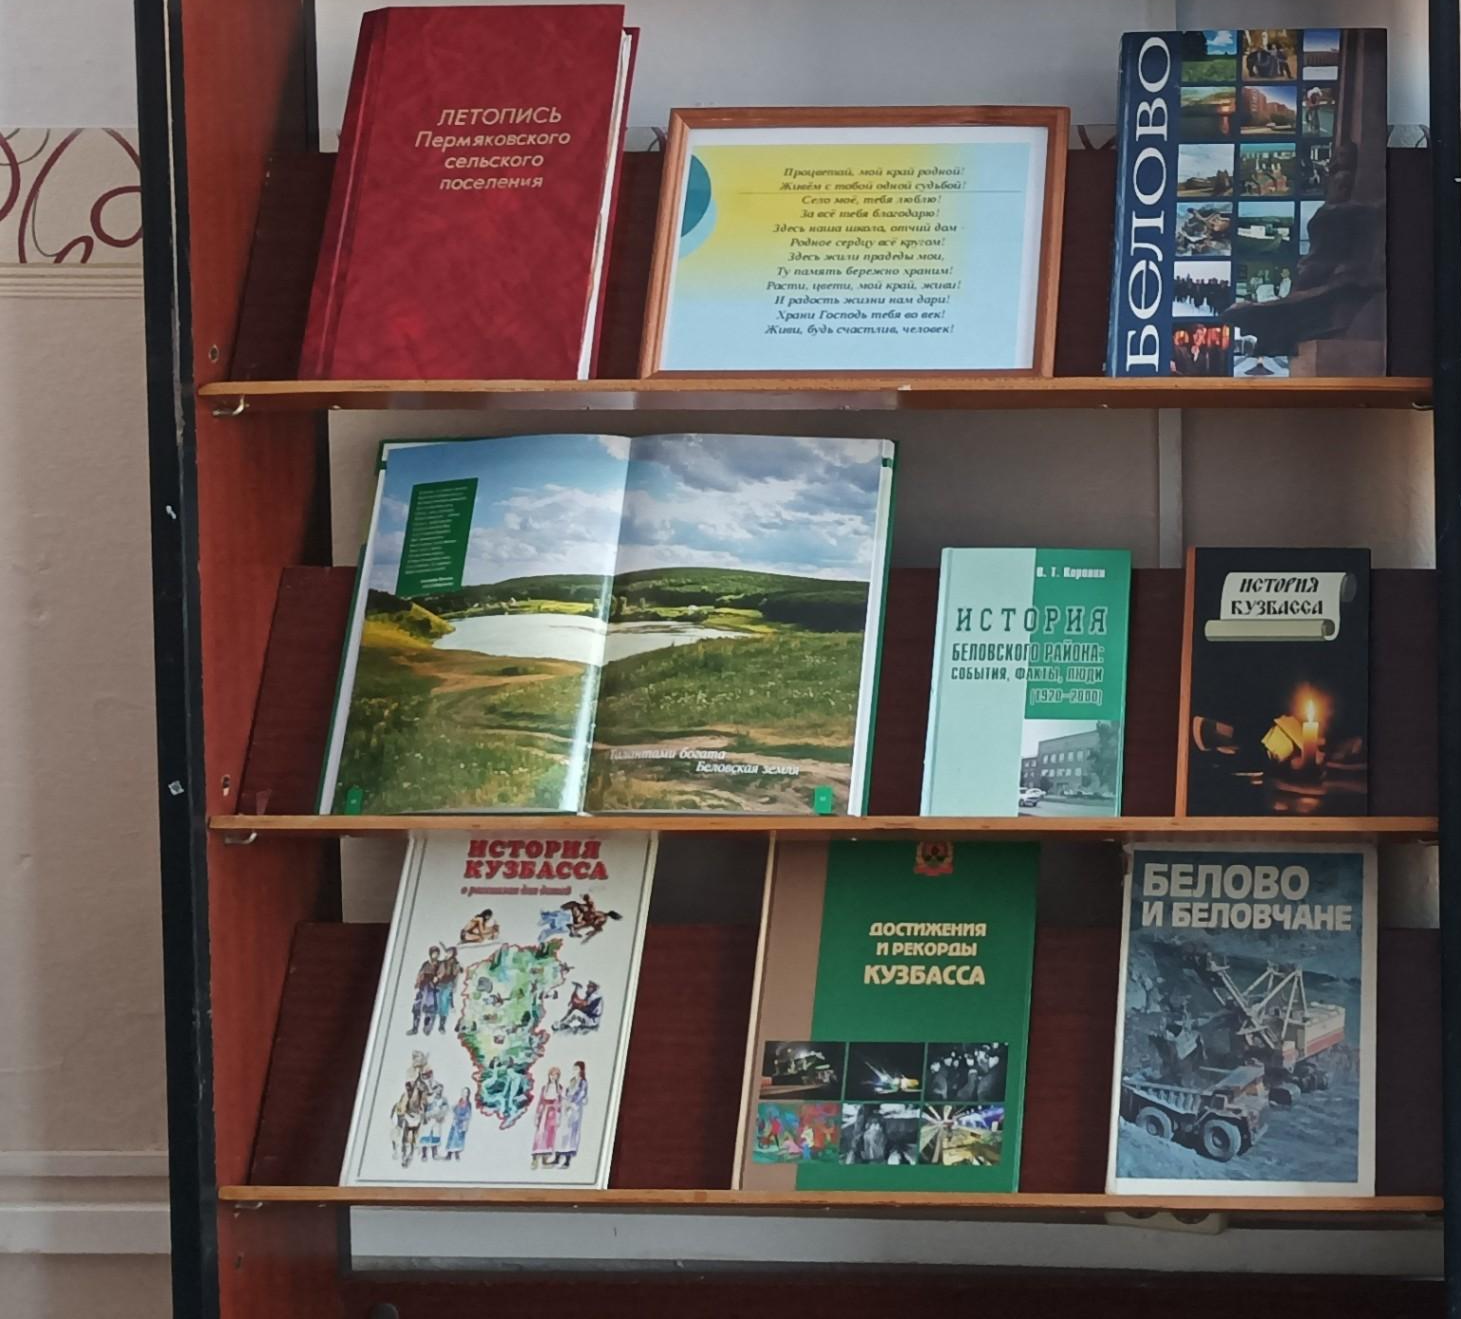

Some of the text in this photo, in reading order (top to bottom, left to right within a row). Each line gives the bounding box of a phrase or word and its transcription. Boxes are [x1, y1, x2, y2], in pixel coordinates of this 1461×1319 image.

[437, 107, 562, 126] ЛЕТОПИСЬ
[415, 131, 570, 152] Пермяковского
[445, 154, 544, 169] сельского
[859, 168, 883, 176] мой
[886, 168, 914, 178] край
[440, 175, 543, 191] поселения
[835, 182, 873, 191] тобой
[876, 182, 912, 191] одной
[863, 195, 893, 204] тебя
[839, 209, 869, 218] тебя
[773, 224, 805, 233] Здесь
[790, 238, 832, 247] Родное
[788, 253, 820, 261] Здесь
[824, 253, 860, 261] жили
[794, 267, 842, 276] память
[845, 266, 900, 278] бережно
[859, 281, 883, 290] мой
[788, 296, 840, 307] радость
[843, 296, 886, 305] жизни
[889, 296, 914, 304] нам
[776, 311, 815, 321] Храни
[819, 310, 868, 320] Господь
[871, 310, 901, 319] тебя
[921, 310, 946, 319] век!
[806, 325, 834, 336] будь
[902, 325, 955, 334] человек!
[1238, 576, 1320, 593] ИСТОРИЯ
[1231, 599, 1324, 616] КУЗБАССА
[955, 607, 1107, 633] ИСТОРИЯ
[951, 639, 1104, 663] БЕЛОВСКОГО РАЙОНА:
[951, 667, 1104, 684] СОБЫТИЯ, ФАКТЫ, ЛЮДИ
[679, 747, 727, 760] богата
[695, 761, 759, 774] Беловская
[467, 840, 602, 859] ИСТОРИЯ
[464, 860, 609, 880] КУЗБАССА
[1143, 863, 1310, 900] БЕЛОВО
[1141, 901, 1352, 931] И БЕЛОВЧАНЕ
[869, 922, 987, 938] ДОСТИЖЕНИЯ
[877, 942, 978, 958] И РЕКОРДЫ
[863, 965, 986, 986] КУЗБАССА
